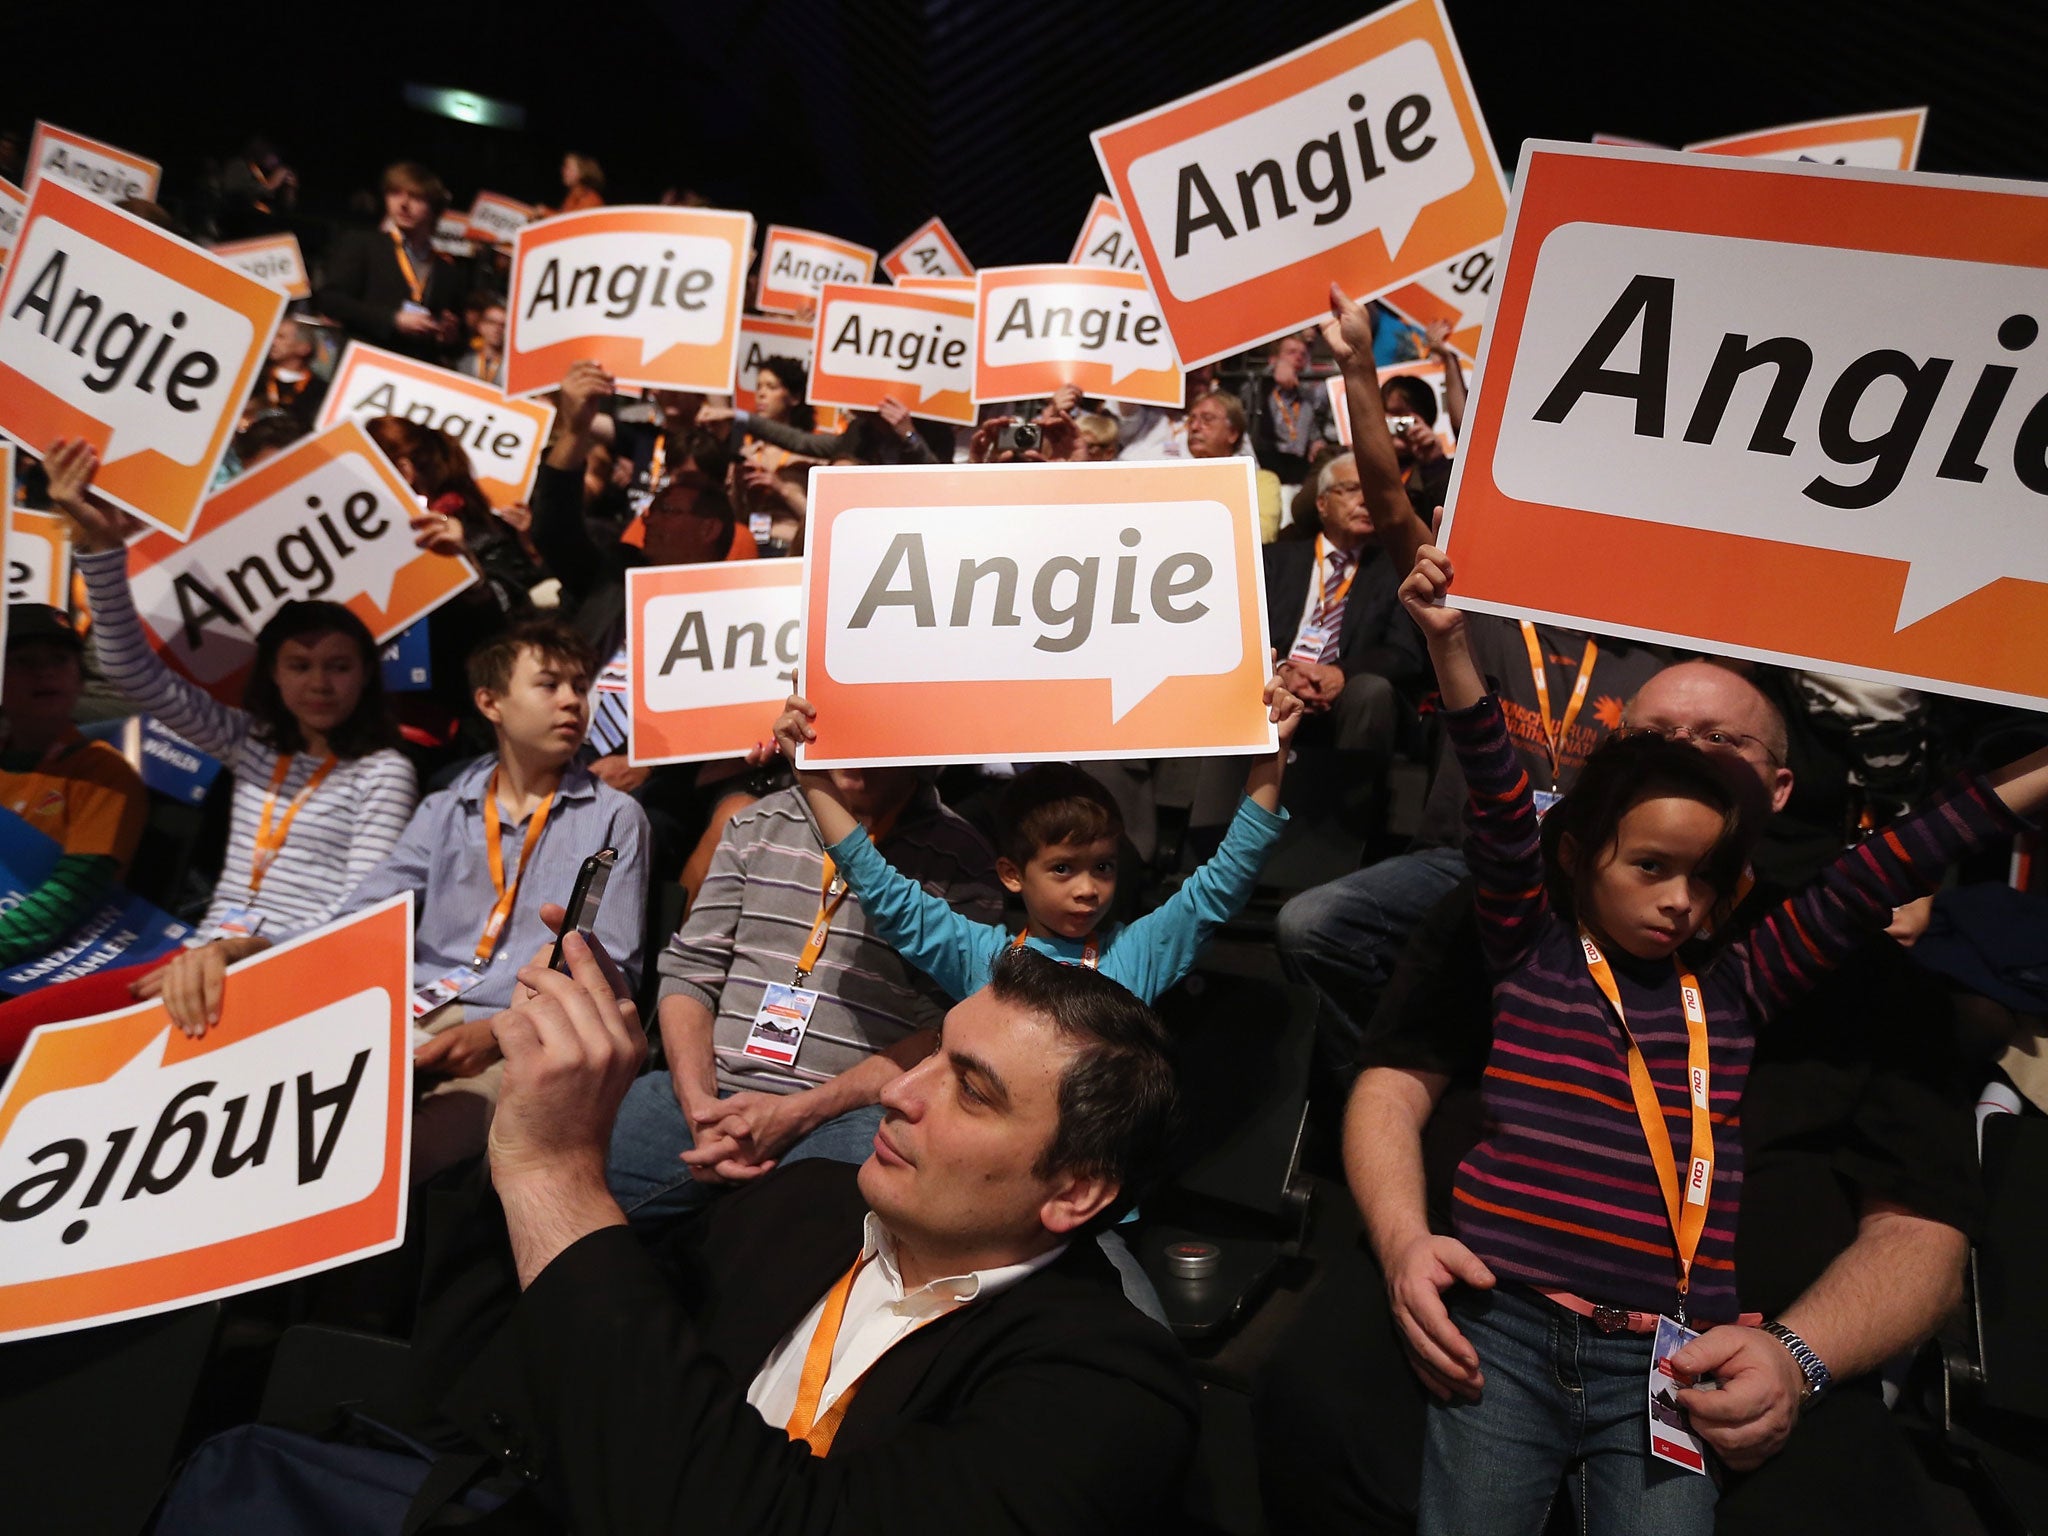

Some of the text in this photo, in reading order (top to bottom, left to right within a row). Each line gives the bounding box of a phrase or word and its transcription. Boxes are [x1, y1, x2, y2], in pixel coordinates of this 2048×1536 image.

[45, 147, 143, 201] Angie
[1174, 93, 1438, 259] Angie
[525, 249, 714, 319] Angie
[11, 249, 221, 412] Angie
[832, 314, 967, 371] Angie
[995, 298, 1163, 350] Angie
[353, 382, 521, 460] Angie
[172, 491, 391, 651] Angie
[847, 527, 1214, 654] Angie
[658, 611, 800, 681] Ang
[49, 929, 140, 984] WÄHLEN
[1584, 942, 1599, 962] CDU
[1684, 988, 1697, 1010] CDU
[1693, 1069, 1702, 1095] CDU
[0, 1048, 373, 1245] Angie
[1692, 1160, 1705, 1190] CDU
